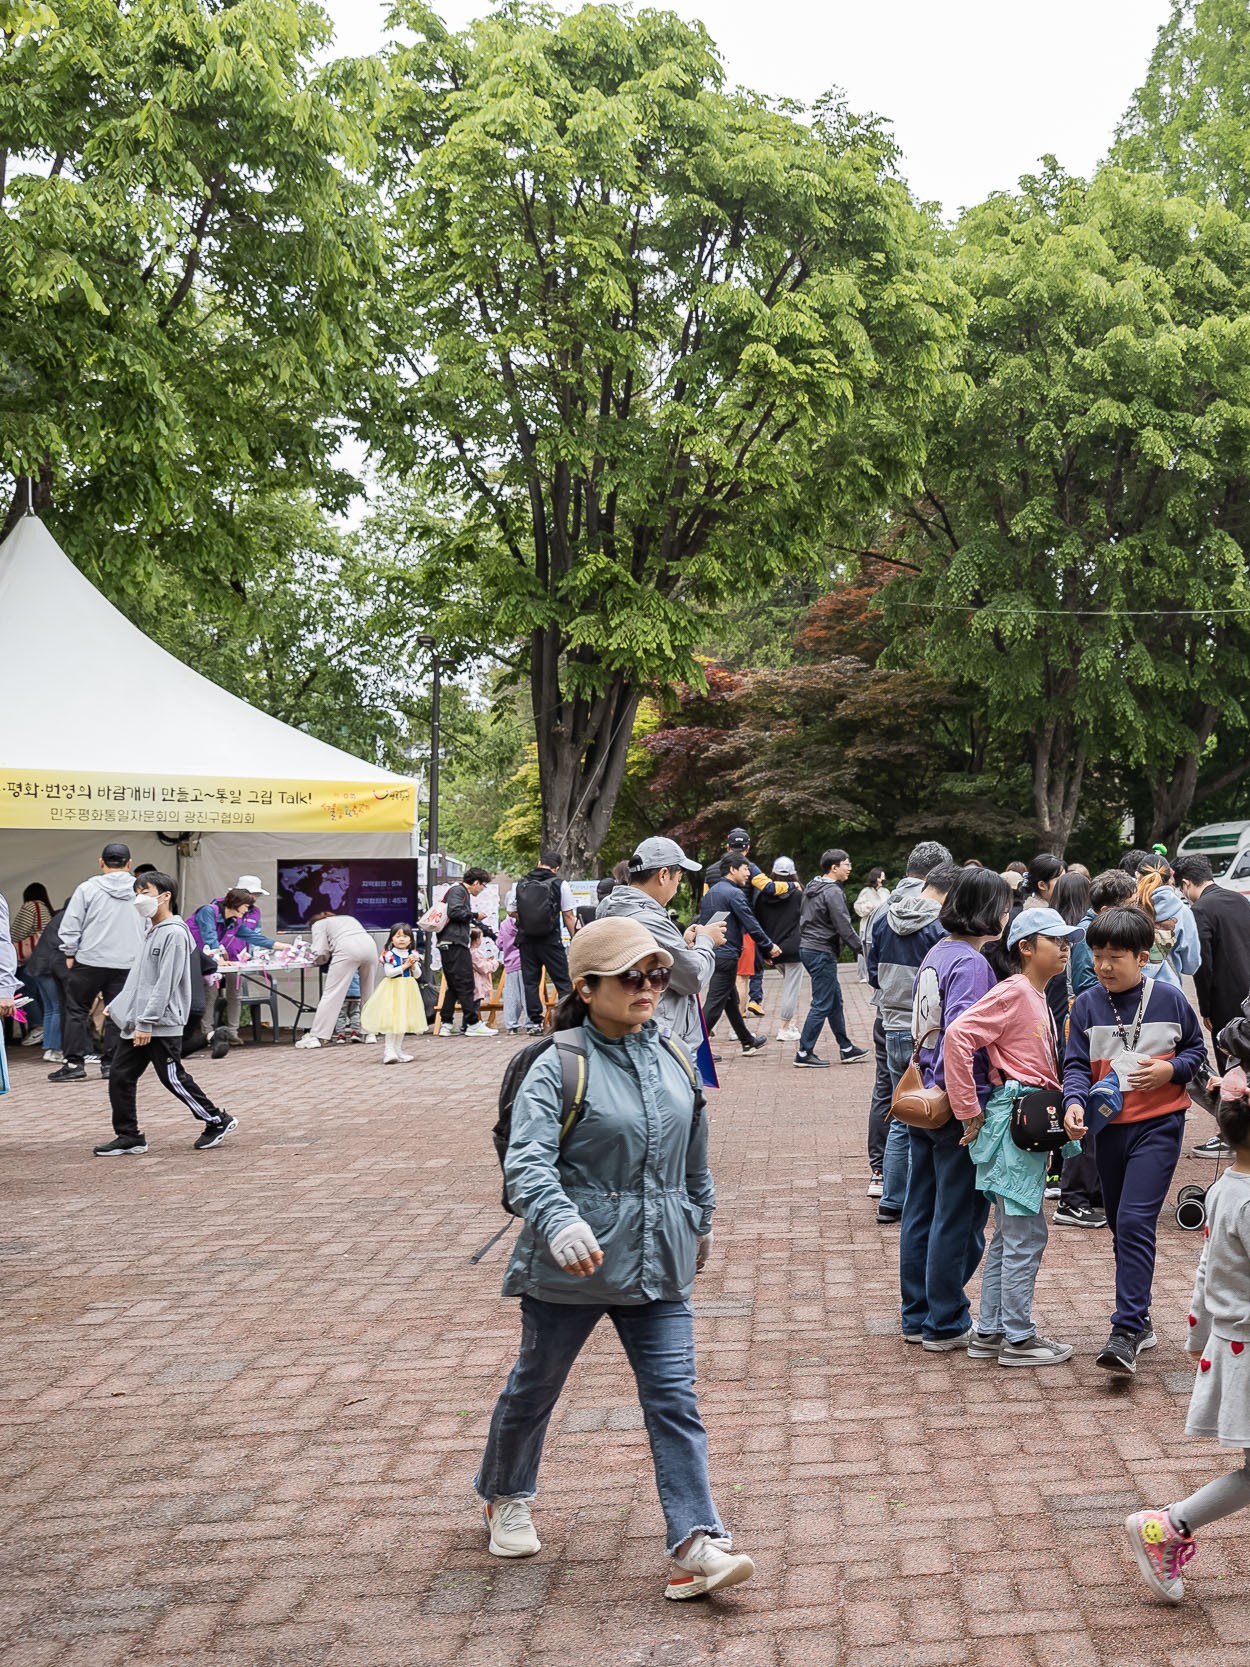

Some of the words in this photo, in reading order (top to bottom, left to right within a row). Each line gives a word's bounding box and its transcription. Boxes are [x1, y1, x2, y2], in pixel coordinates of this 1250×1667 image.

[0, 781, 92, 800] ·평화·번영의
[97, 784, 156, 802] 바람개비
[161, 786, 242, 804] 만들고~통일
[278, 791, 312, 805] Talk!
[50, 807, 180, 823] 민주평화통일자문회의
[184, 810, 255, 824] 광진구협의회
